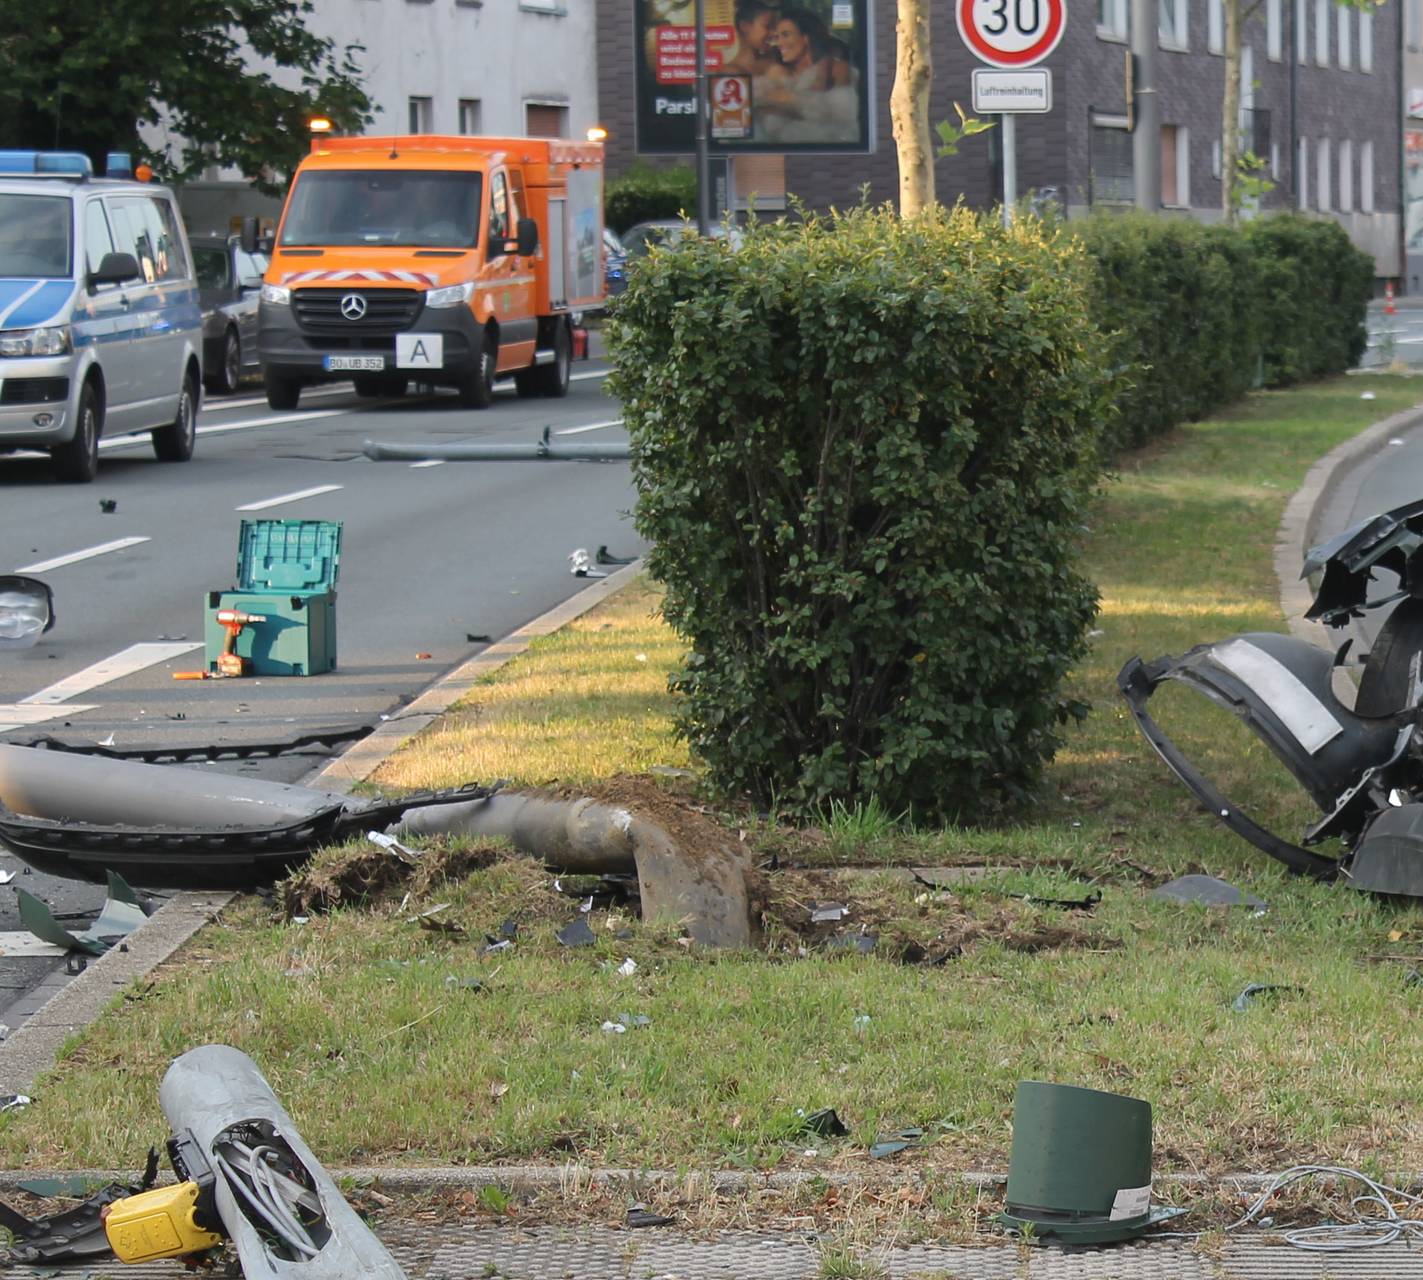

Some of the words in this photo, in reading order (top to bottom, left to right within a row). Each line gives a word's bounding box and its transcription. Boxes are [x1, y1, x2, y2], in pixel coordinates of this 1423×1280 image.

[982, 0, 1041, 36] 30
[979, 86, 1044, 100] Luftreinhaltung
[408, 339, 430, 363] A
